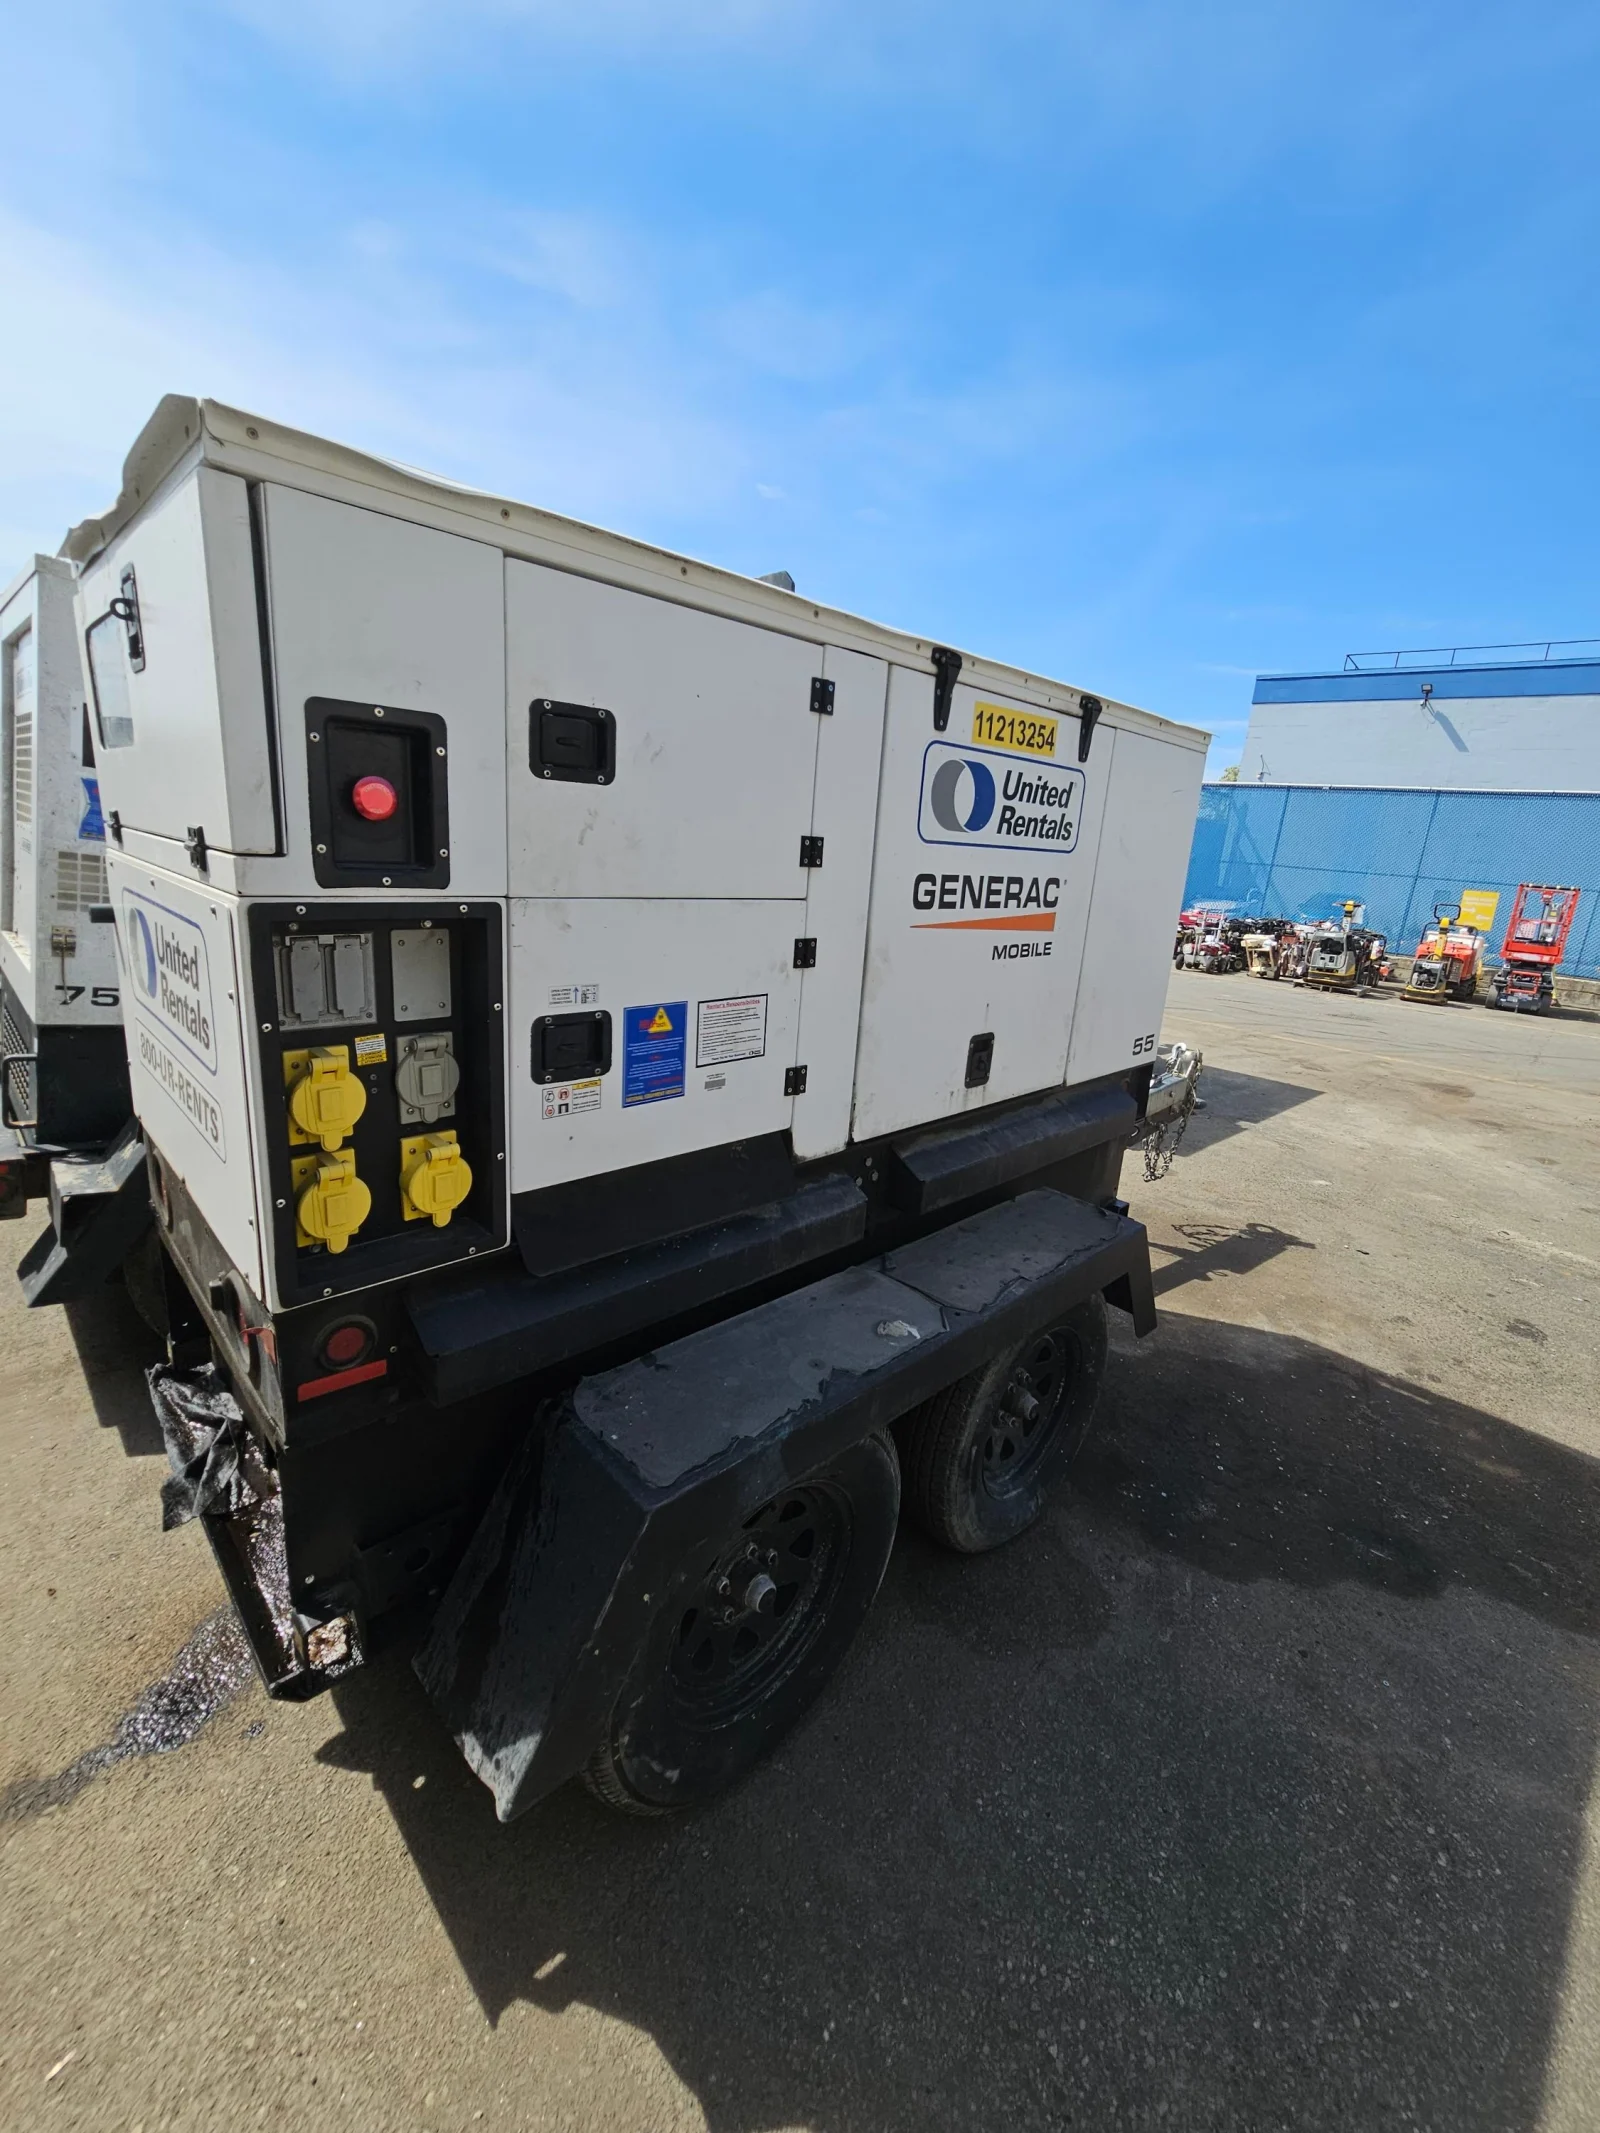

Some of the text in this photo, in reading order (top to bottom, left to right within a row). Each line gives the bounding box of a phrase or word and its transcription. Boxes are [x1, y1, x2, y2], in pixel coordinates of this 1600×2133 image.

[976, 710, 1055, 751] 11213254
[1002, 770, 1073, 808] United
[996, 805, 1073, 841] Rentals
[912, 873, 1060, 910] GENERAC
[154, 921, 200, 992] United
[992, 942, 1053, 960] MOBILE
[55, 985, 120, 1007] 75
[160, 971, 210, 1050] Rentals
[1132, 1034, 1155, 1056] 55
[140, 1031, 219, 1144] 800-UR-RENTS
